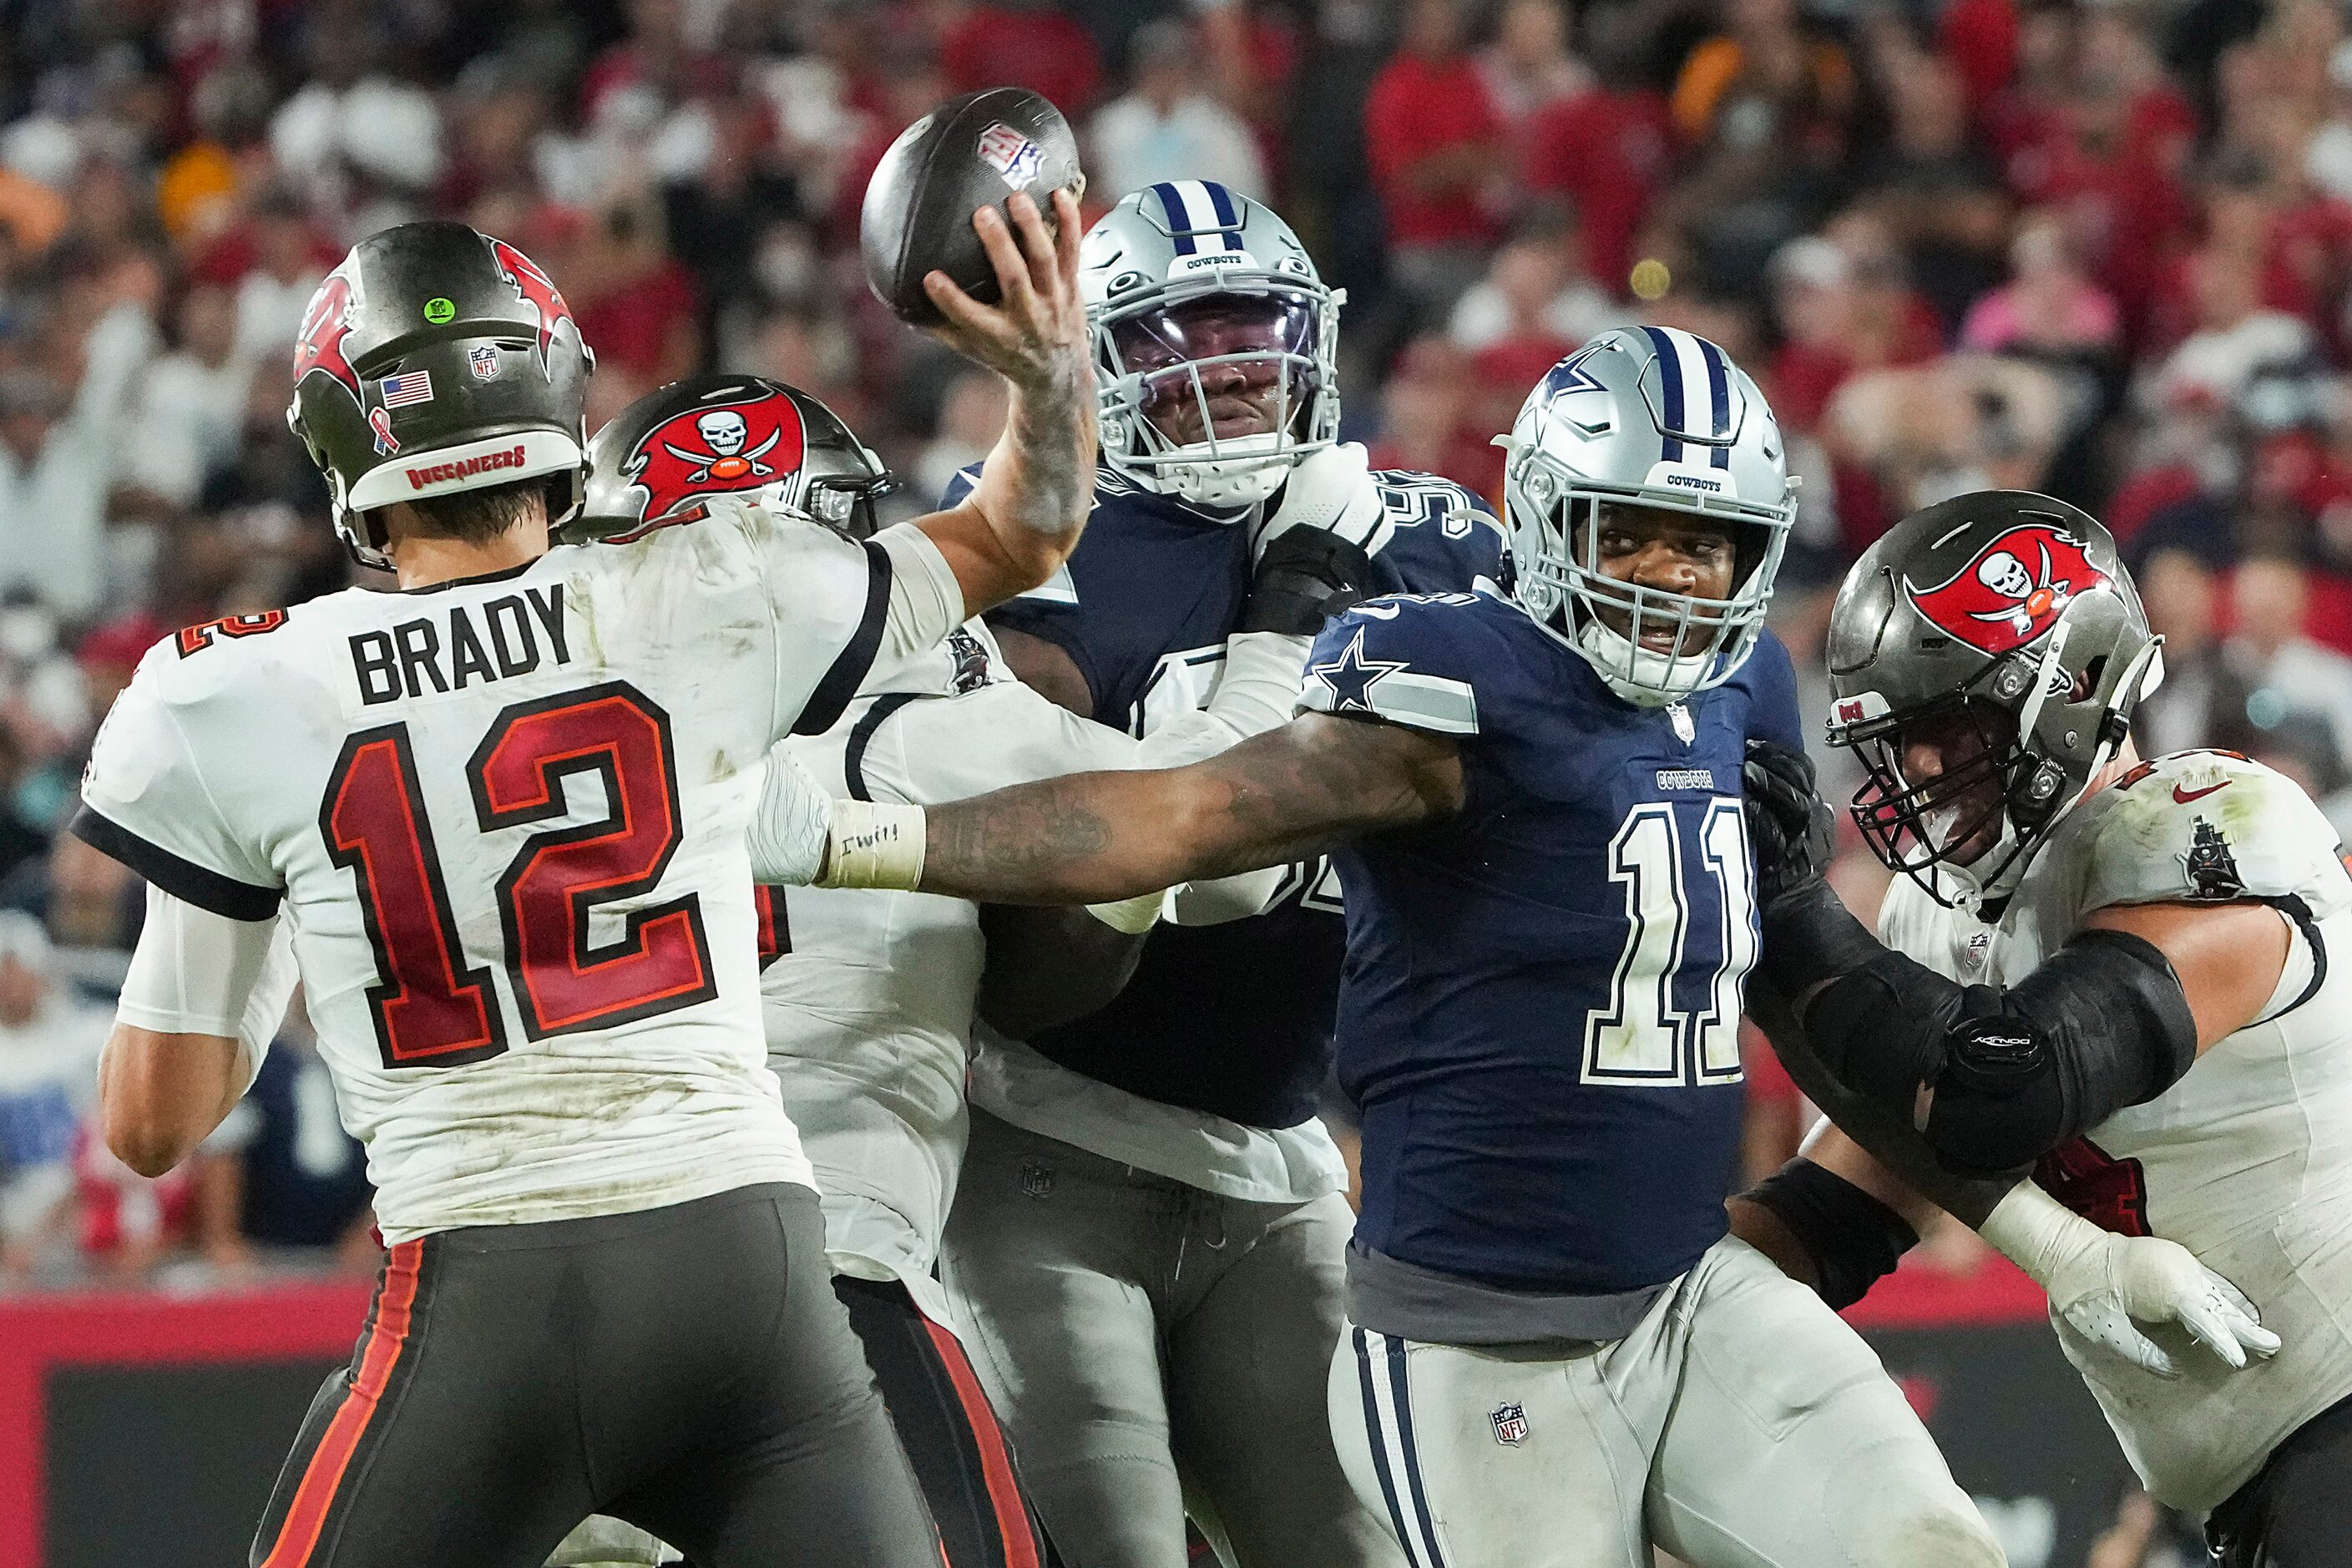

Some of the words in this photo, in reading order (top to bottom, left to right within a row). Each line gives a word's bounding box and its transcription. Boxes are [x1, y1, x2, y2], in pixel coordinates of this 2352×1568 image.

[1186, 255, 1242, 269] COWBOYS
[475, 359, 497, 376] NFL
[406, 445, 525, 490] BUCCANEERS
[1667, 474, 1722, 492] COWBOYS
[348, 584, 571, 706] BRADY
[1657, 770, 1714, 790] COWBOYS
[318, 680, 719, 1070] 12
[1579, 796, 1758, 1087] 11
[1970, 1036, 2031, 1047] DONJOY
[1499, 1419, 1526, 1439] NFL
